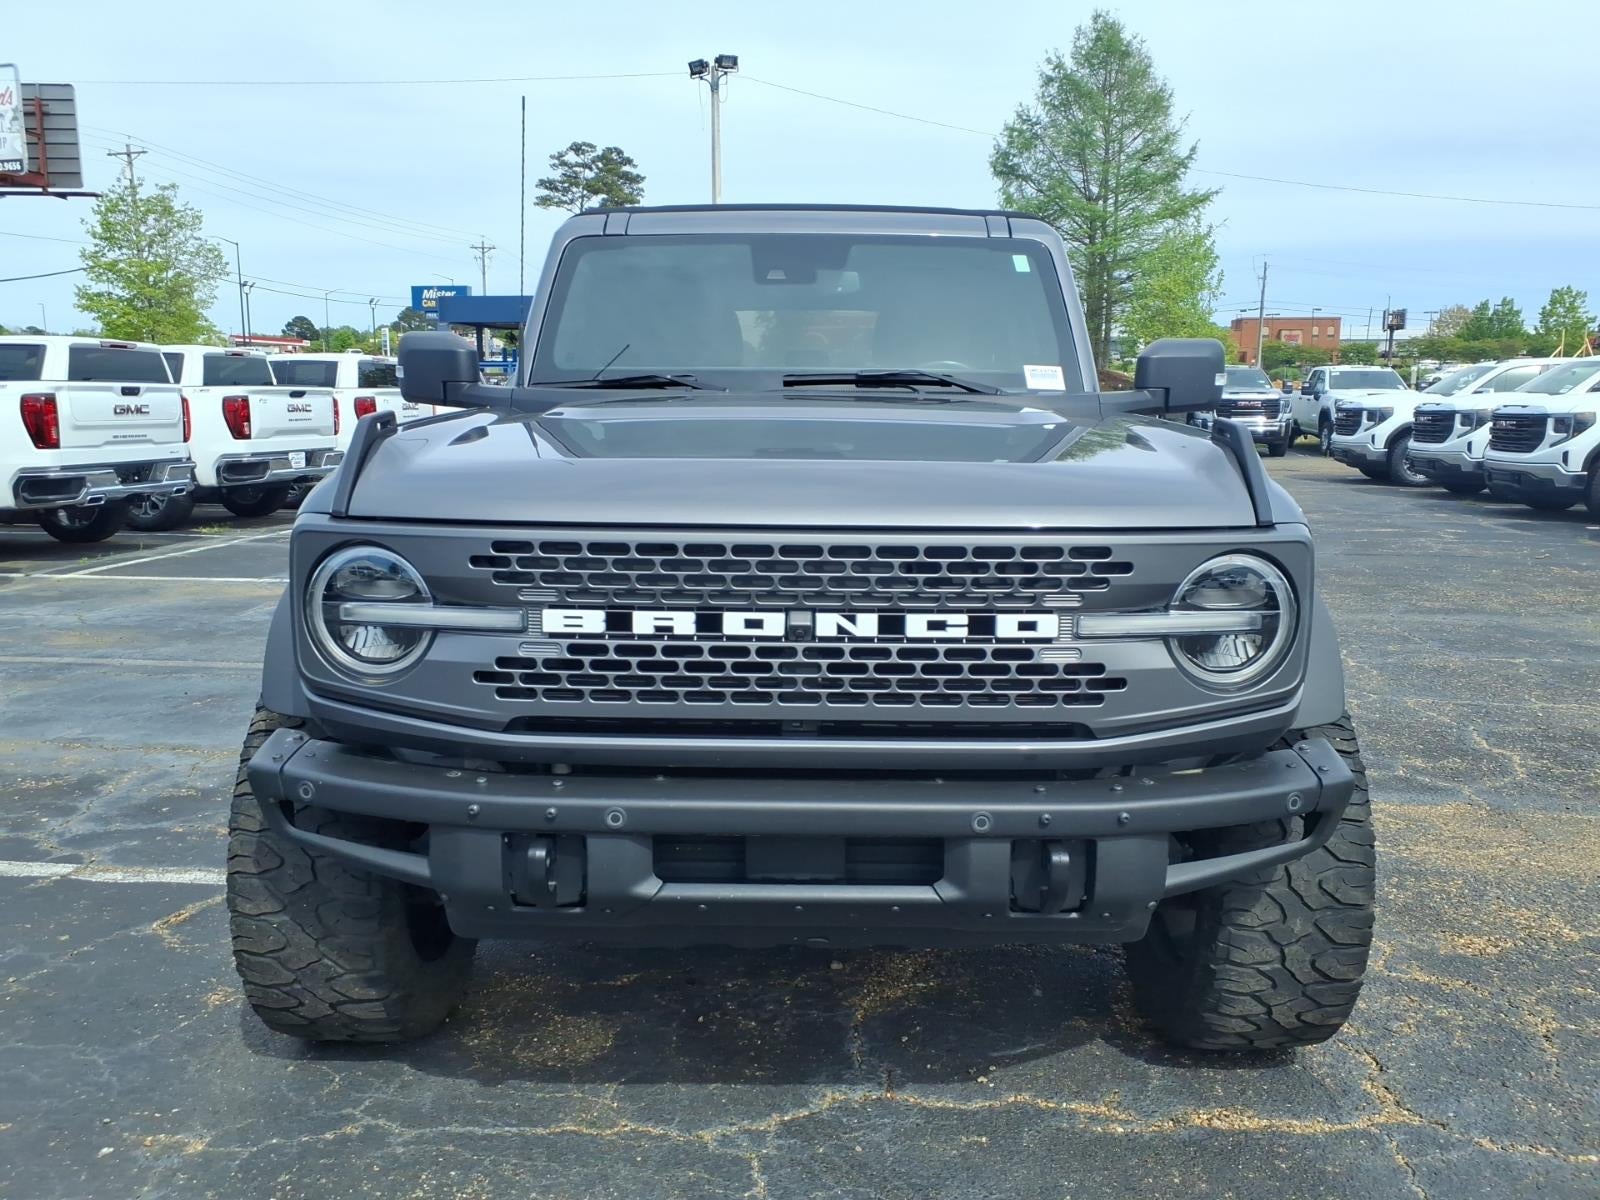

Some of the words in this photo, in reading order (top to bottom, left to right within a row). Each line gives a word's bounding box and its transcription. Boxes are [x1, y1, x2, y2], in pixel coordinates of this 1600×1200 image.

[113, 404, 150, 415] GMC
[287, 404, 312, 413] GMC
[542, 609, 1059, 638] BRONCO
